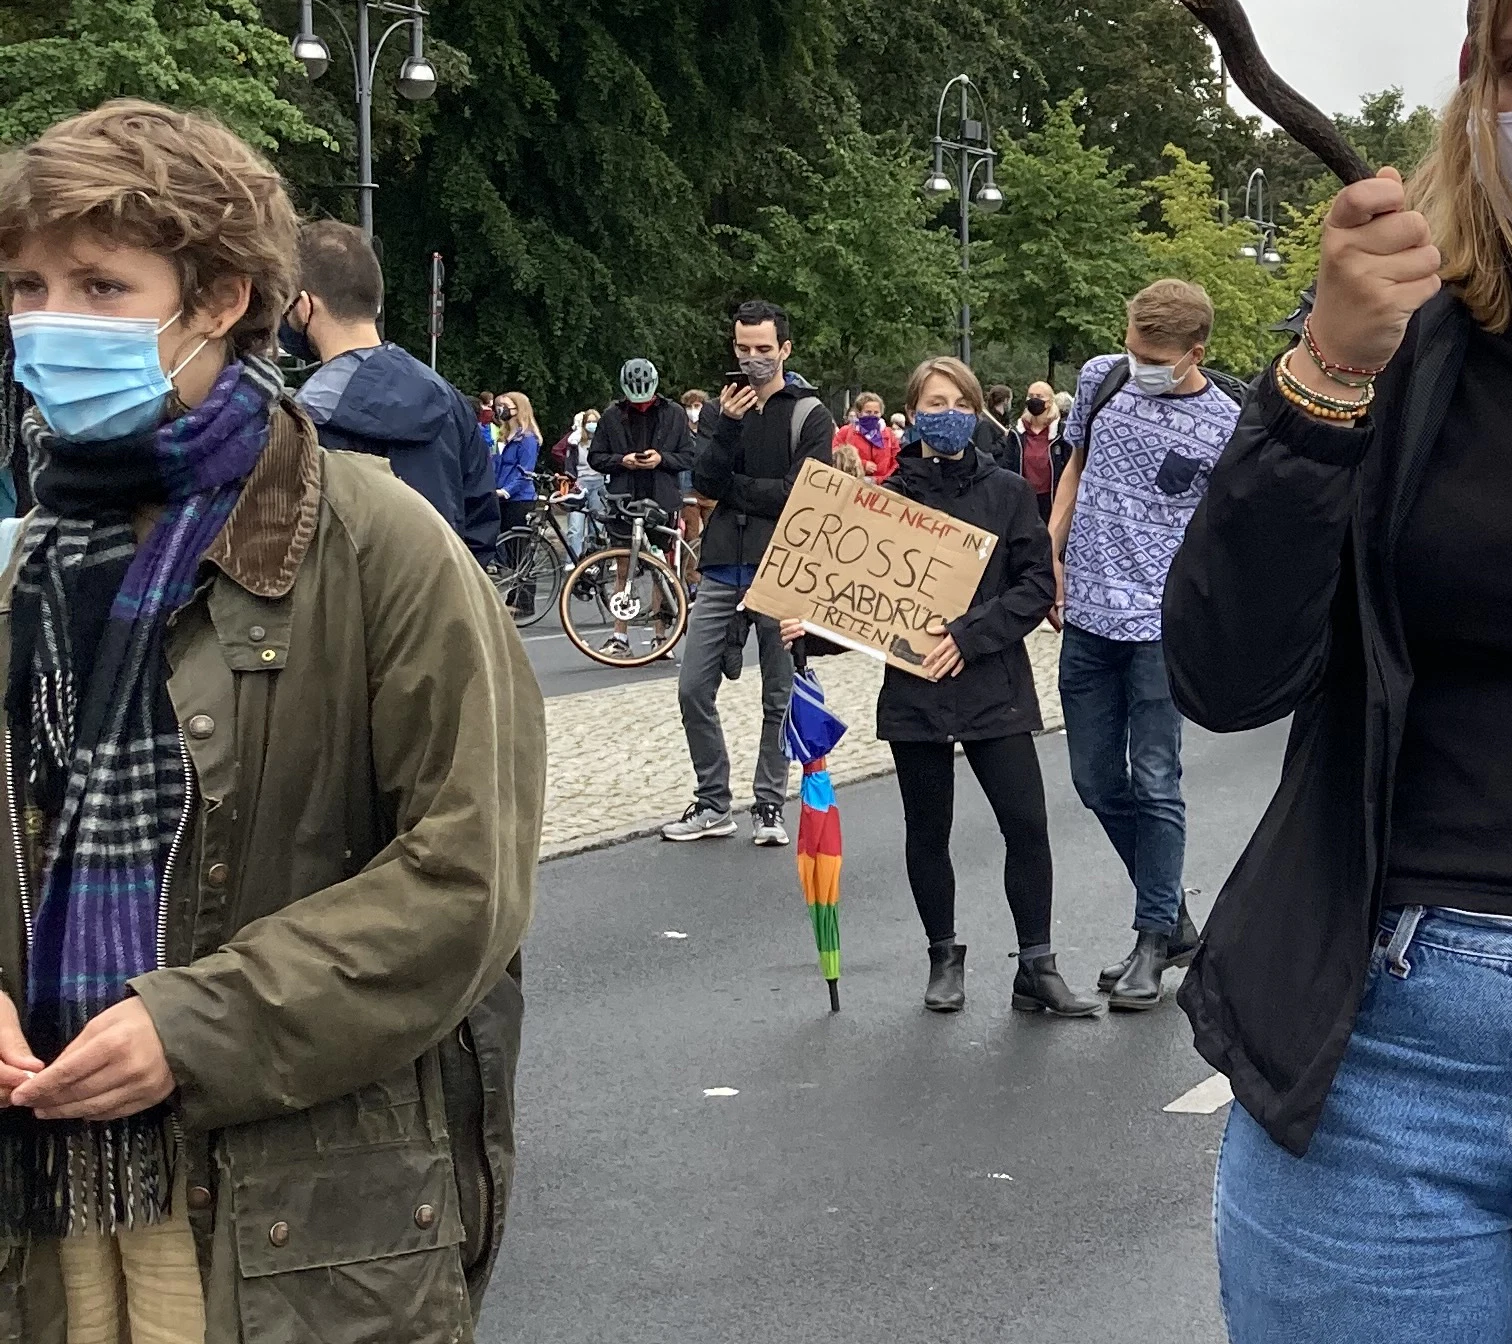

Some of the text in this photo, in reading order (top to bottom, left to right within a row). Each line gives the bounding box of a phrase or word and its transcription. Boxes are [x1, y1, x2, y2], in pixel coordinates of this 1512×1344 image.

[803, 464, 844, 497] ICH
[853, 486, 893, 518] WILL
[899, 507, 962, 540] NICHT
[783, 506, 954, 600] GROSSE
